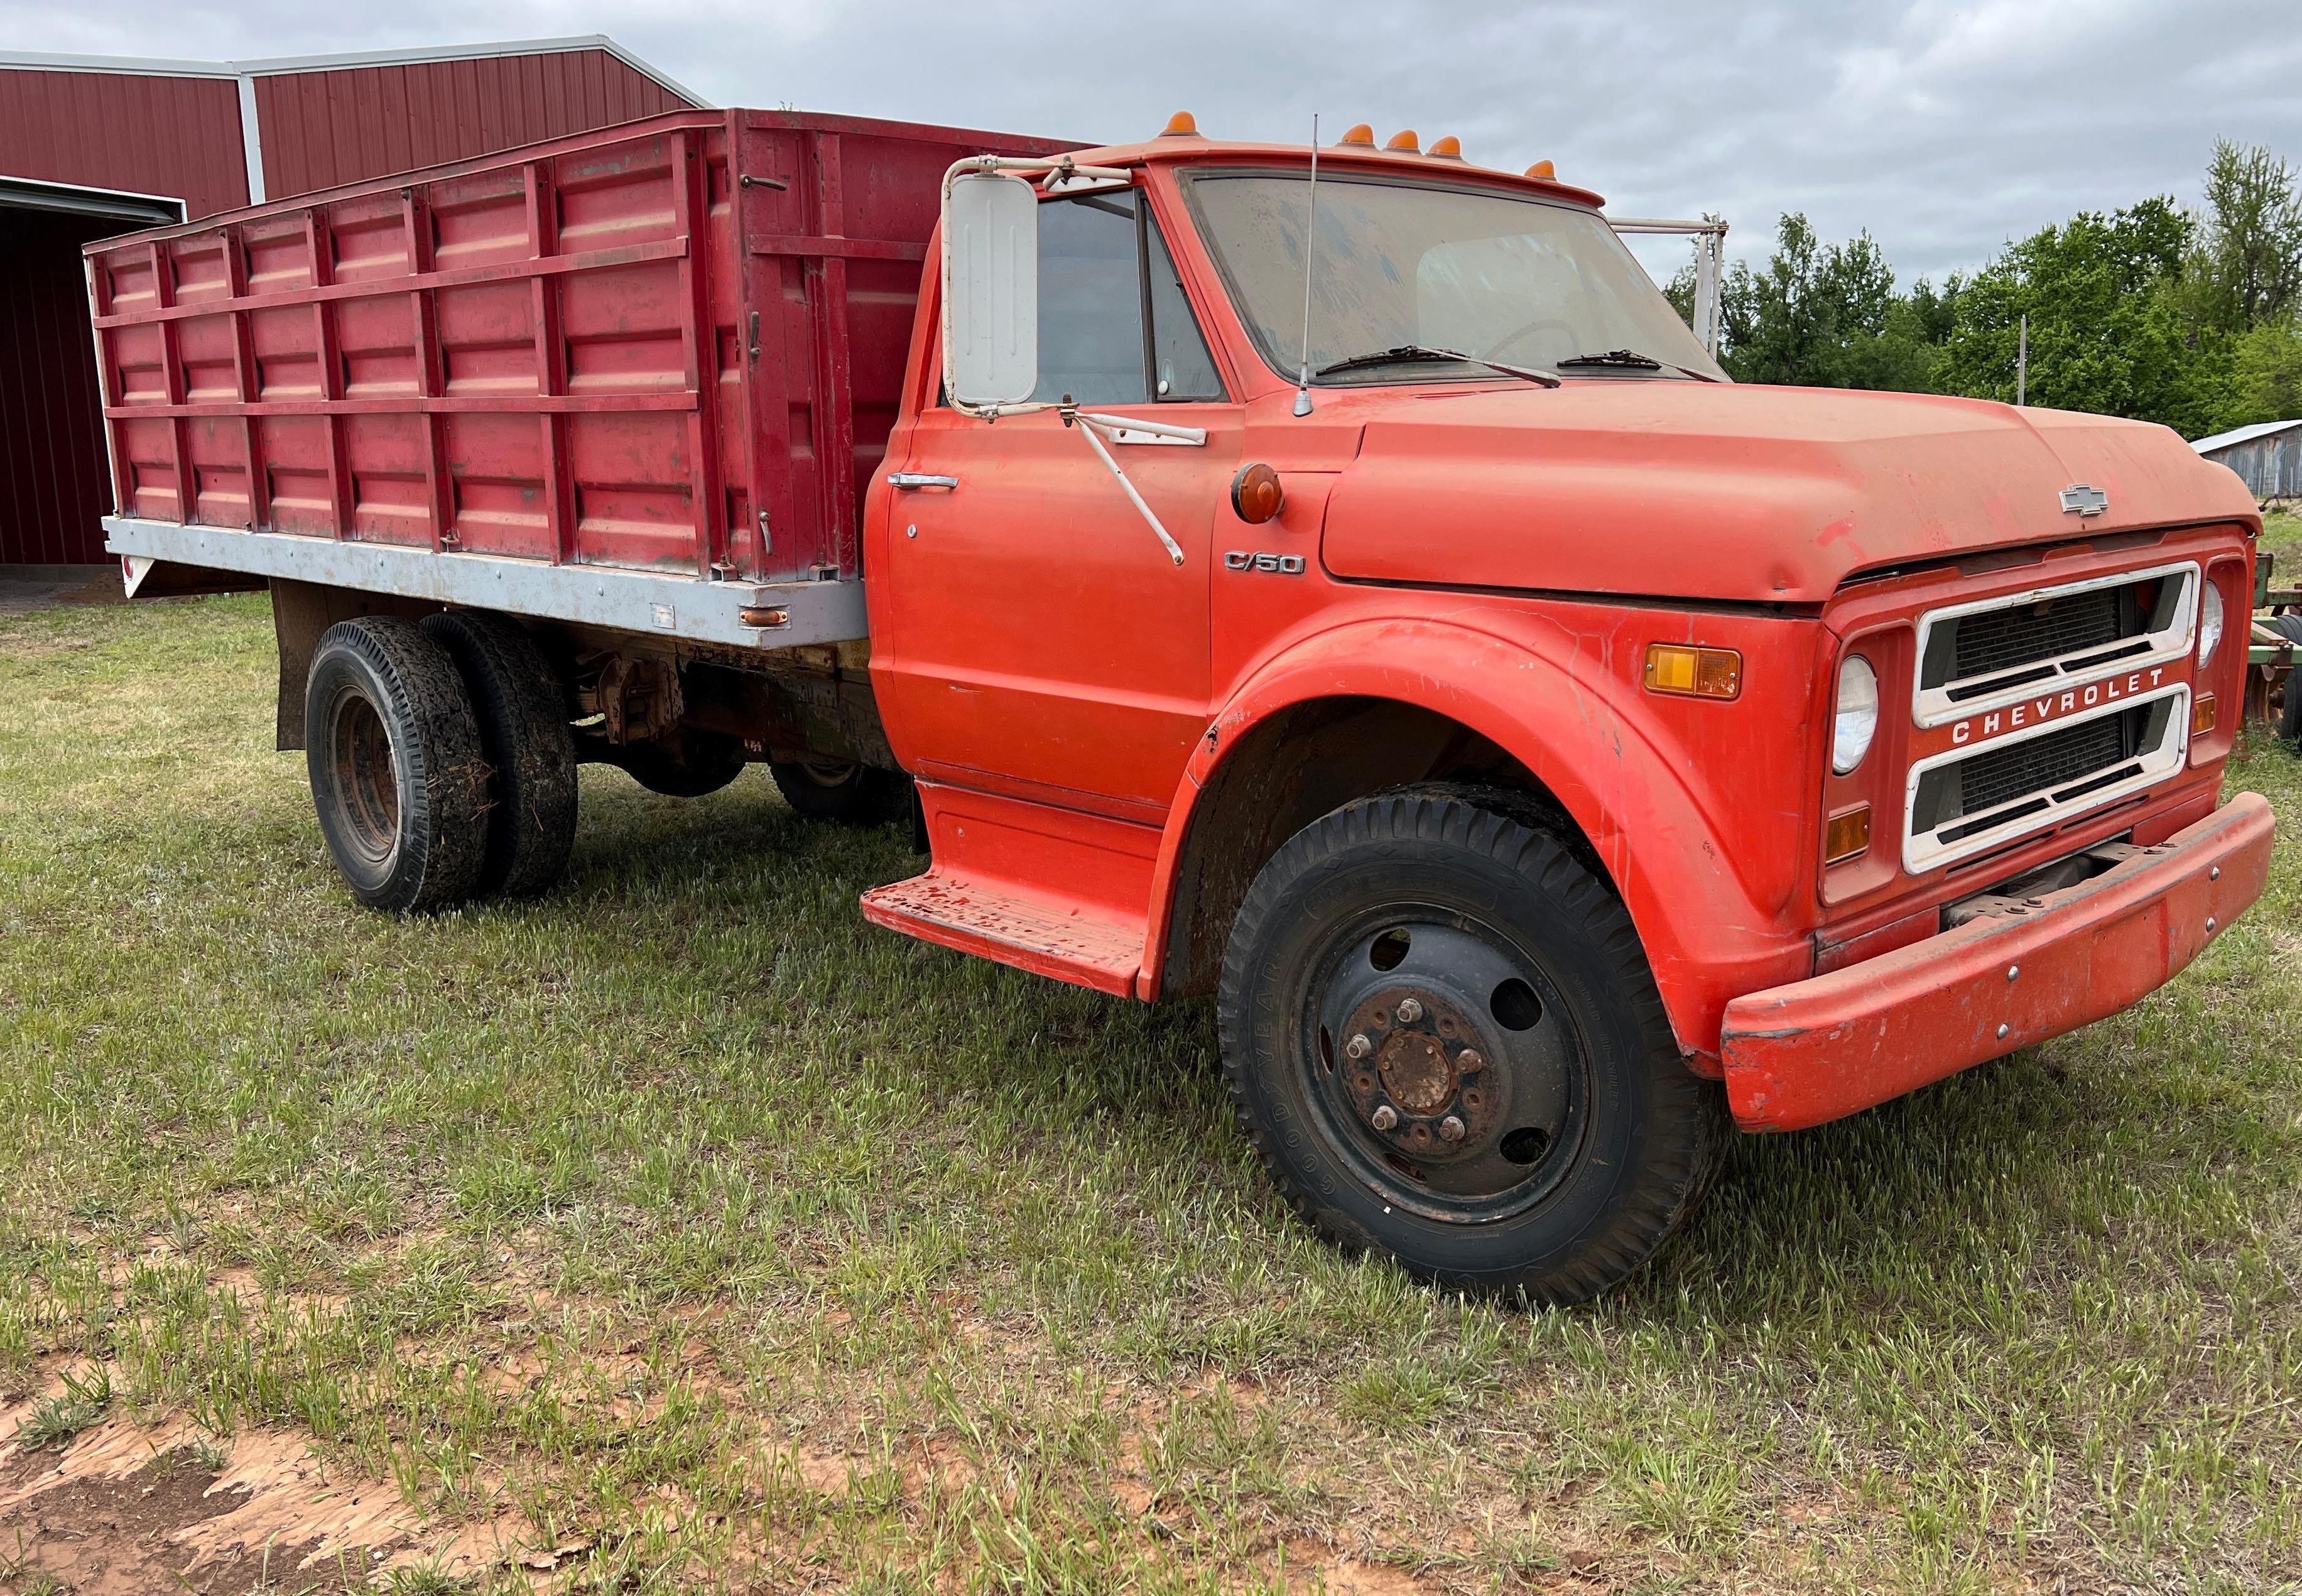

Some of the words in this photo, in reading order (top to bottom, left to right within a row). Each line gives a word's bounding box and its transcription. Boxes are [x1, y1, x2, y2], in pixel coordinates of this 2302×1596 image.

[1225, 550, 1306, 573] C/50
[1952, 668, 2163, 744] CHEVROLET
[1256, 962, 1336, 1195] GOODYEAR
